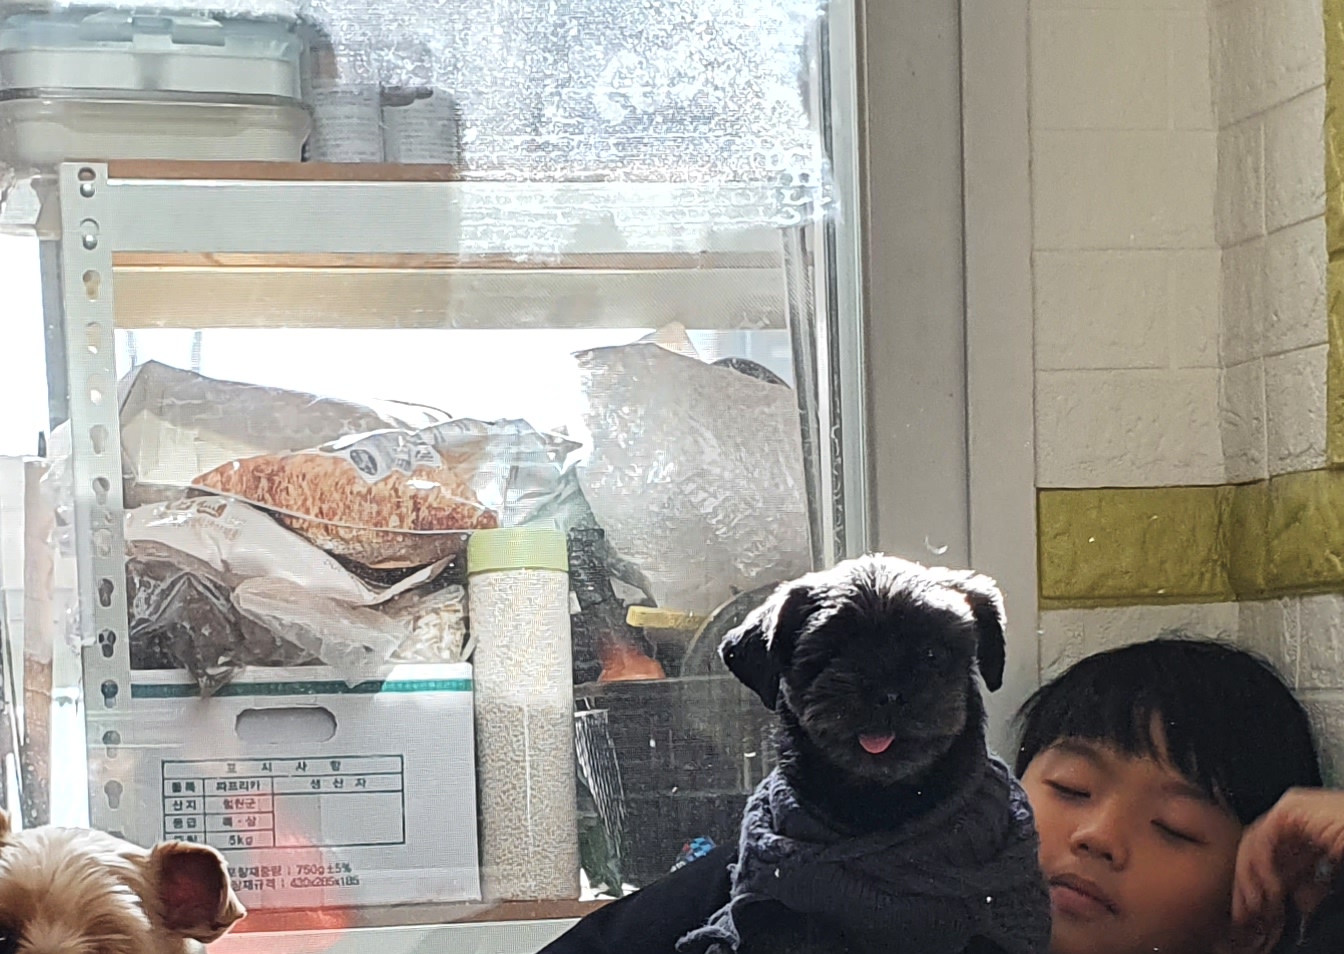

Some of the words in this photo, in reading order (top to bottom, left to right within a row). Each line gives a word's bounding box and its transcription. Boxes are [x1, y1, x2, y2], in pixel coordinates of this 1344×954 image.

[216, 781, 261, 792] 파프리카
[229, 835, 254, 847] 5kg
[230, 877, 277, 892] 장재규격
